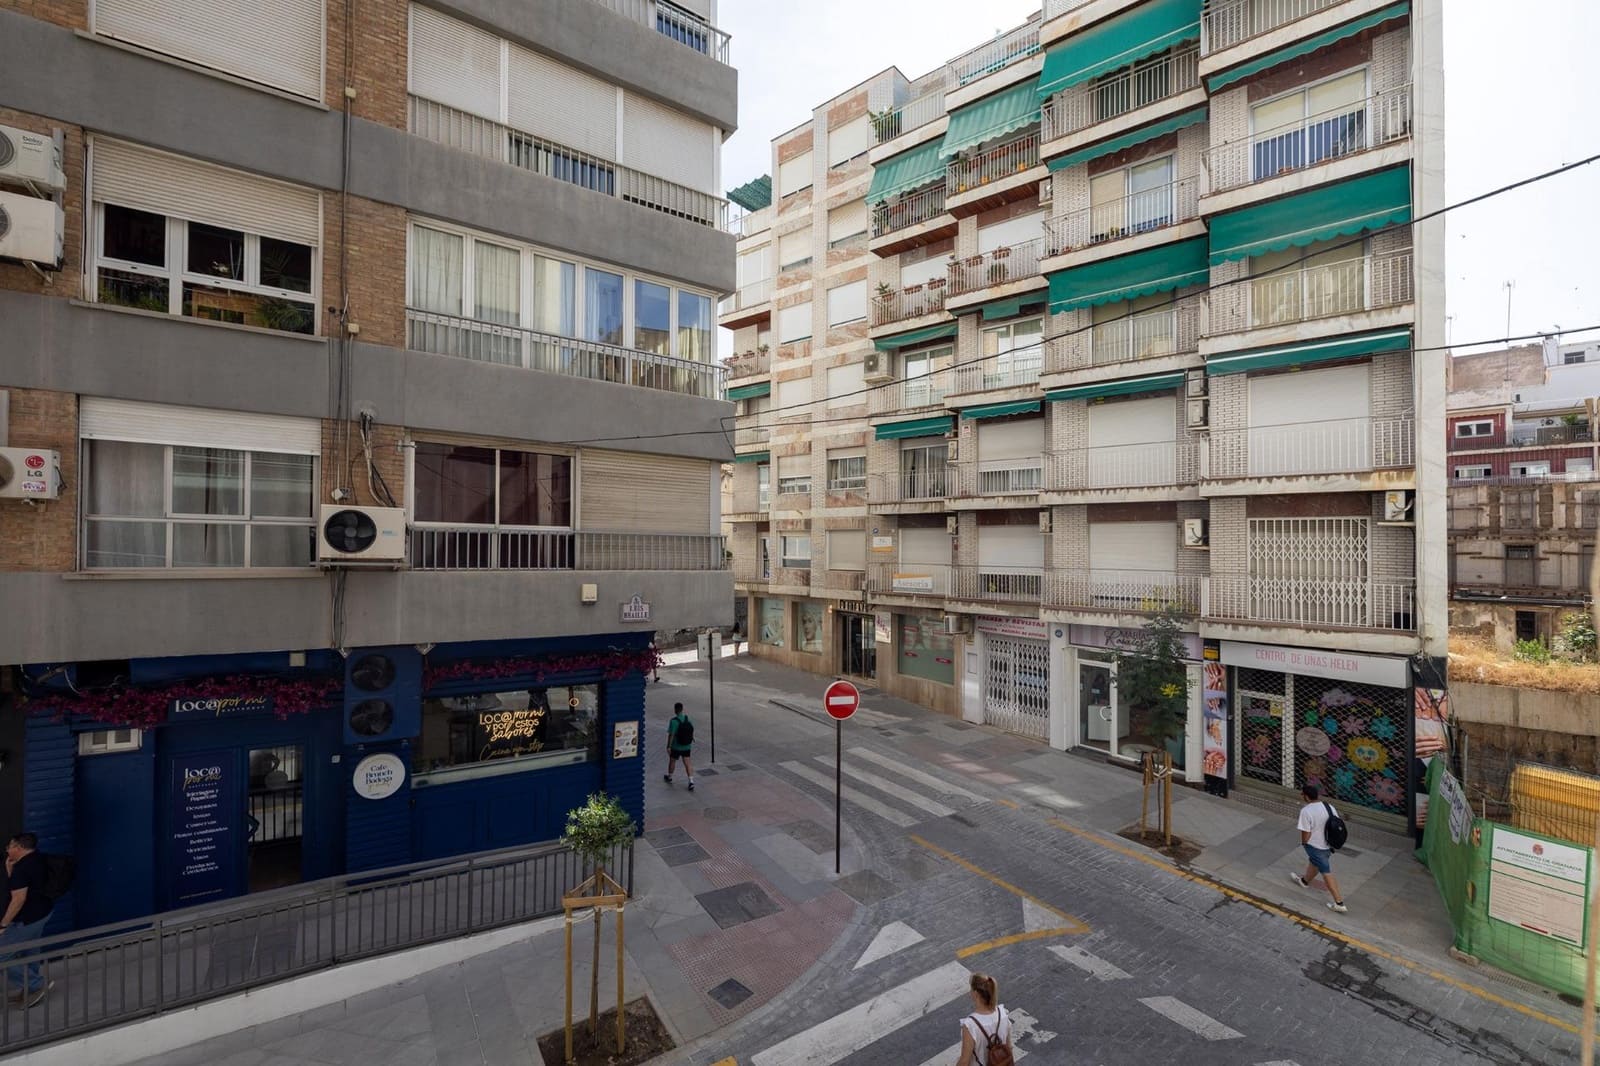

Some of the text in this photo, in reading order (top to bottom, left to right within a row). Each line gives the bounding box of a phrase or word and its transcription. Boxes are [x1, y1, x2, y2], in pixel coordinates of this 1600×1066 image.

[1255, 649, 1286, 662] CENTRO
[1290, 653, 1302, 664] DE
[1330, 658, 1359, 672] HELEN
[480, 711, 512, 725] LOC@
[515, 719, 540, 728] estos
[490, 722, 536, 741] sabores
